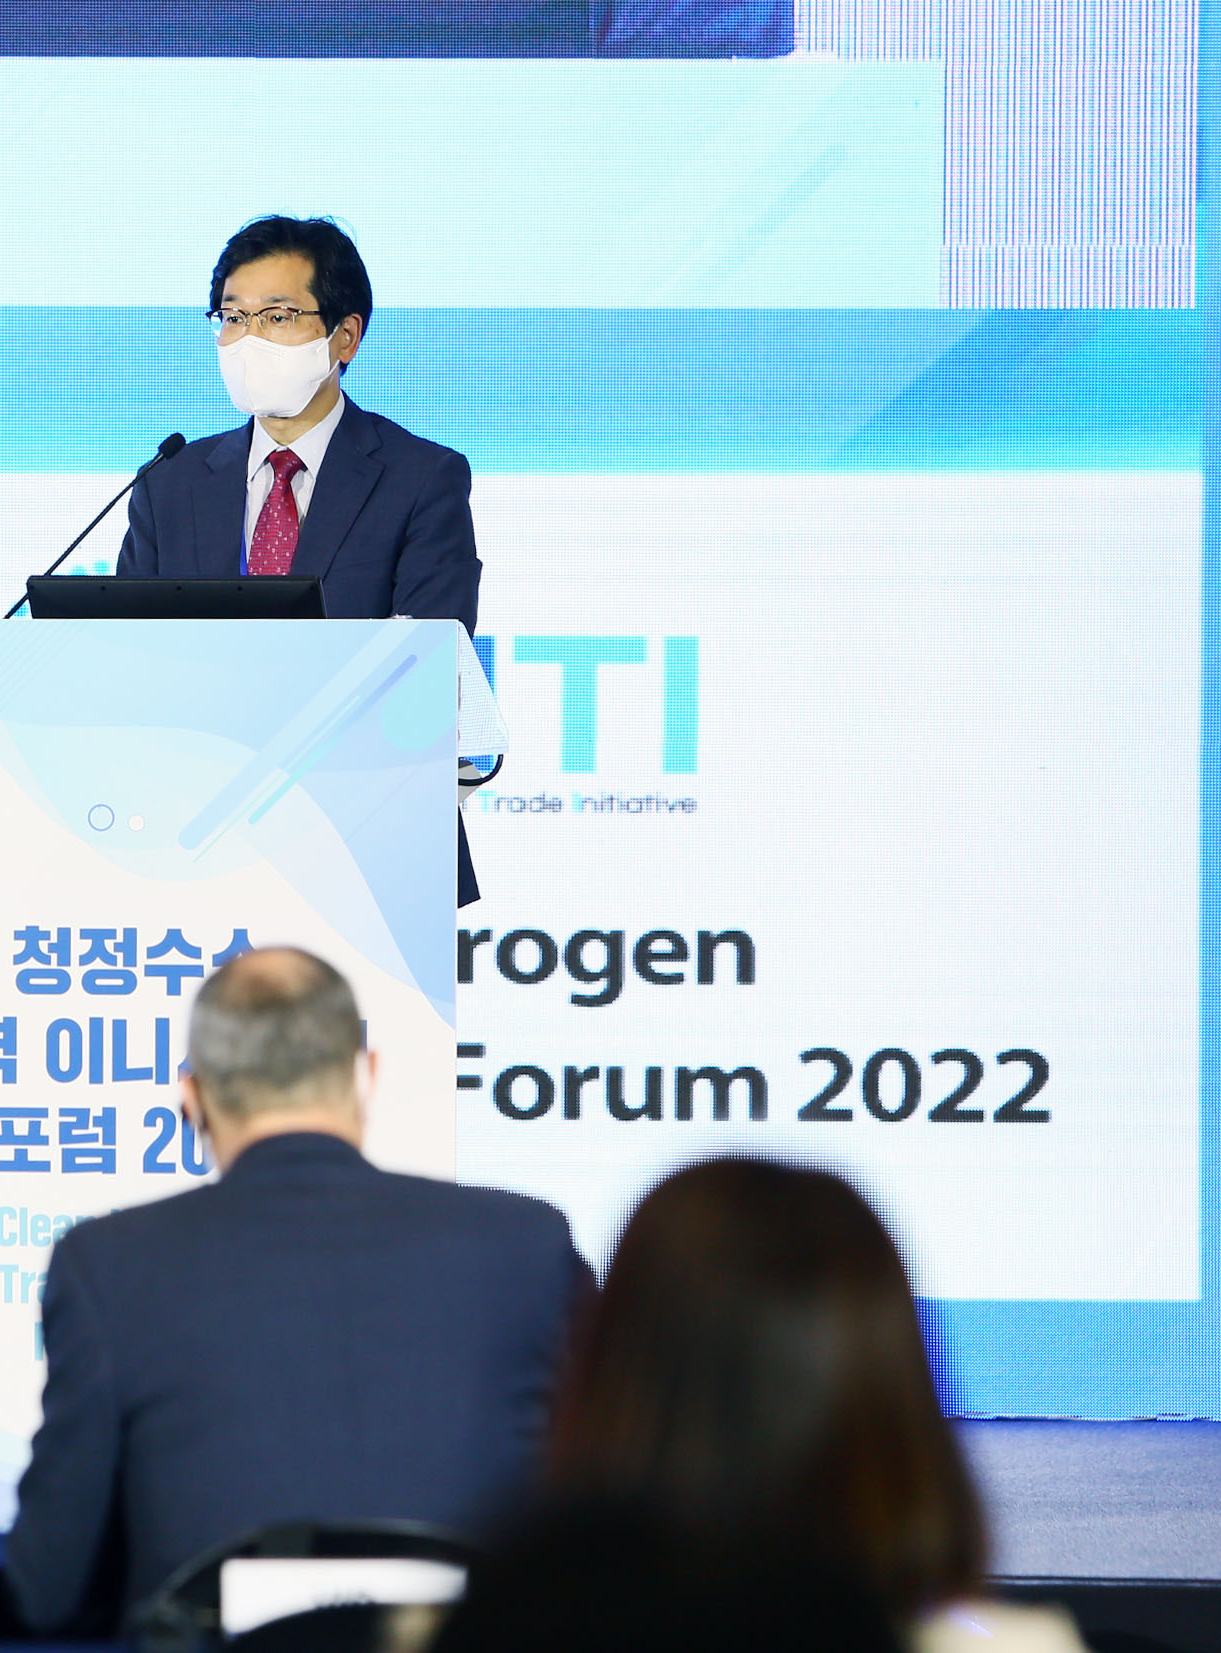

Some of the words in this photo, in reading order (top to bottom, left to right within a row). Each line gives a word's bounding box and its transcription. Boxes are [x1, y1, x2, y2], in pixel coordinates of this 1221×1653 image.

[459, 635, 699, 774] TI
[475, 790, 563, 813] Trade
[572, 790, 698, 814] Initiative
[797, 1046, 1052, 1124] 2022
